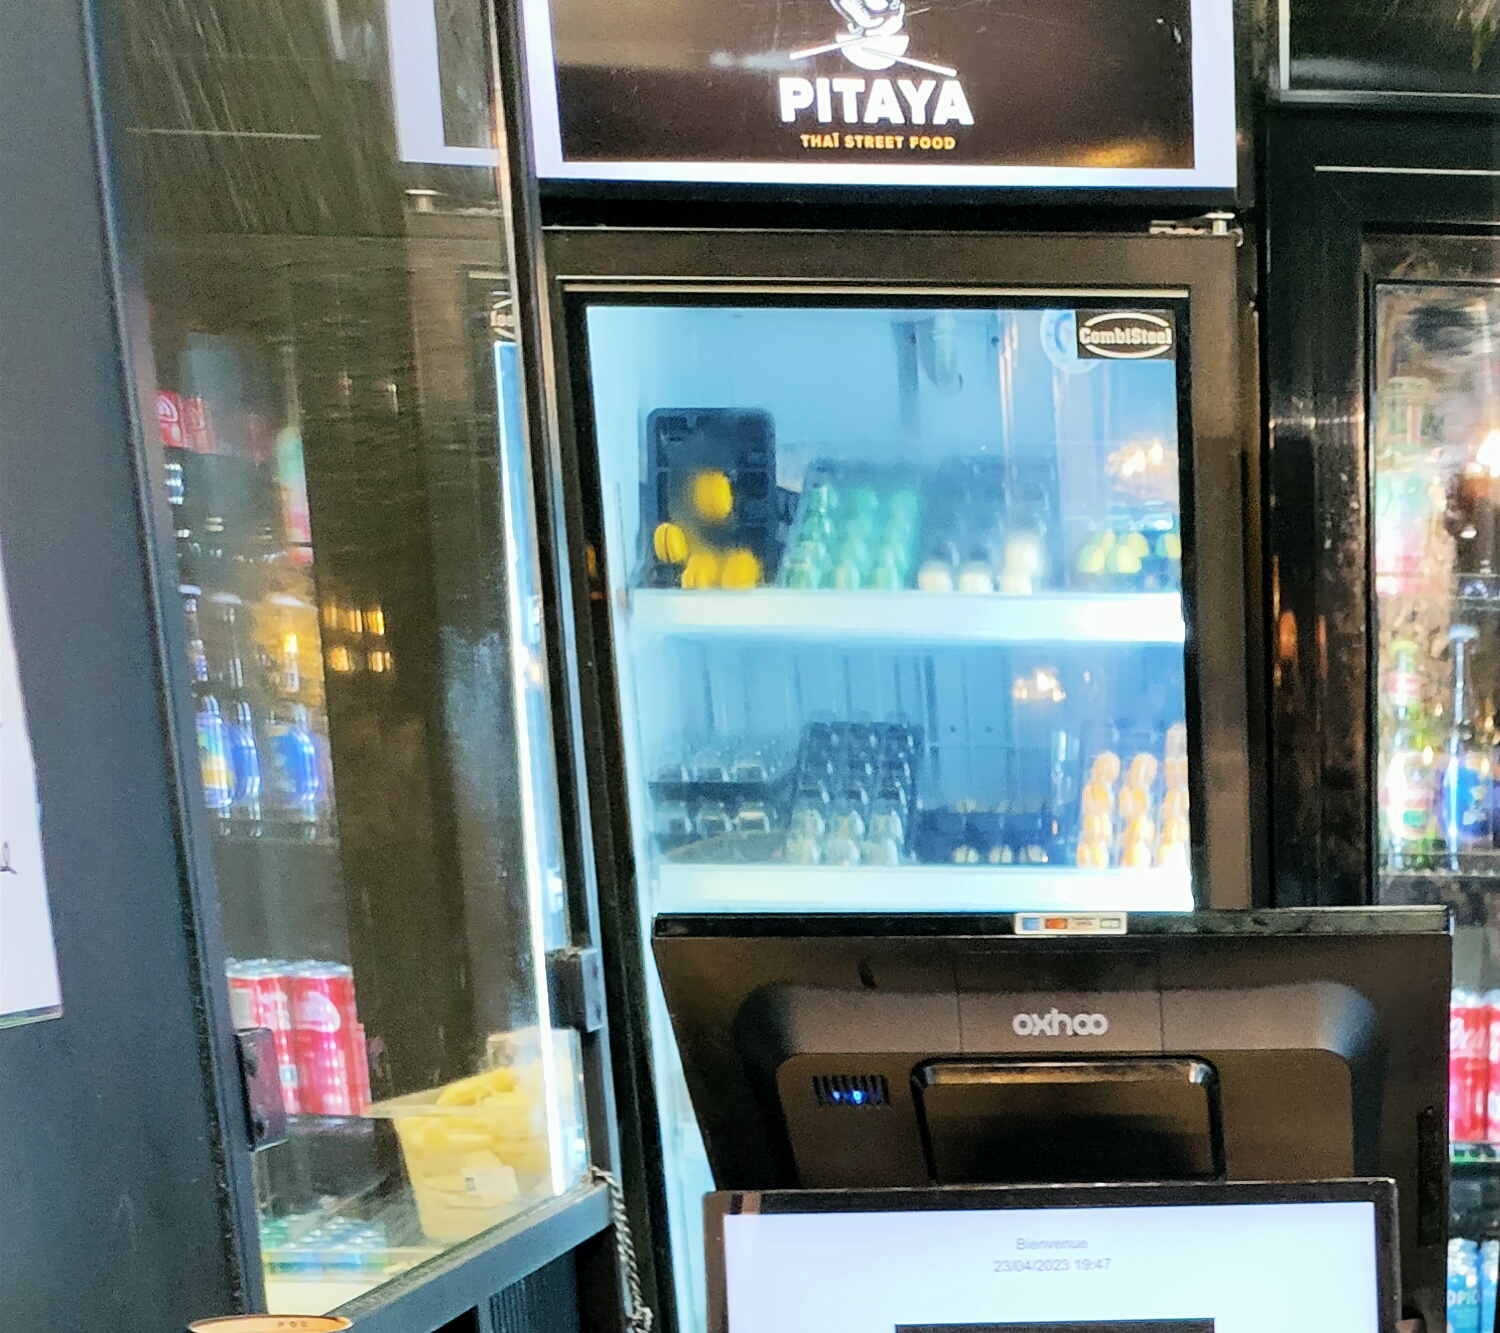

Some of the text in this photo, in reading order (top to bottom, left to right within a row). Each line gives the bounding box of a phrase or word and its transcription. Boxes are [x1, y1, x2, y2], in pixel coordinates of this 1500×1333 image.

[779, 77, 975, 125] PITAYA
[844, 135, 904, 149] STREET
[909, 136, 957, 150] FOOD
[1079, 326, 1173, 345] CombiSteel
[1012, 1007, 1109, 1036] oxhoo
